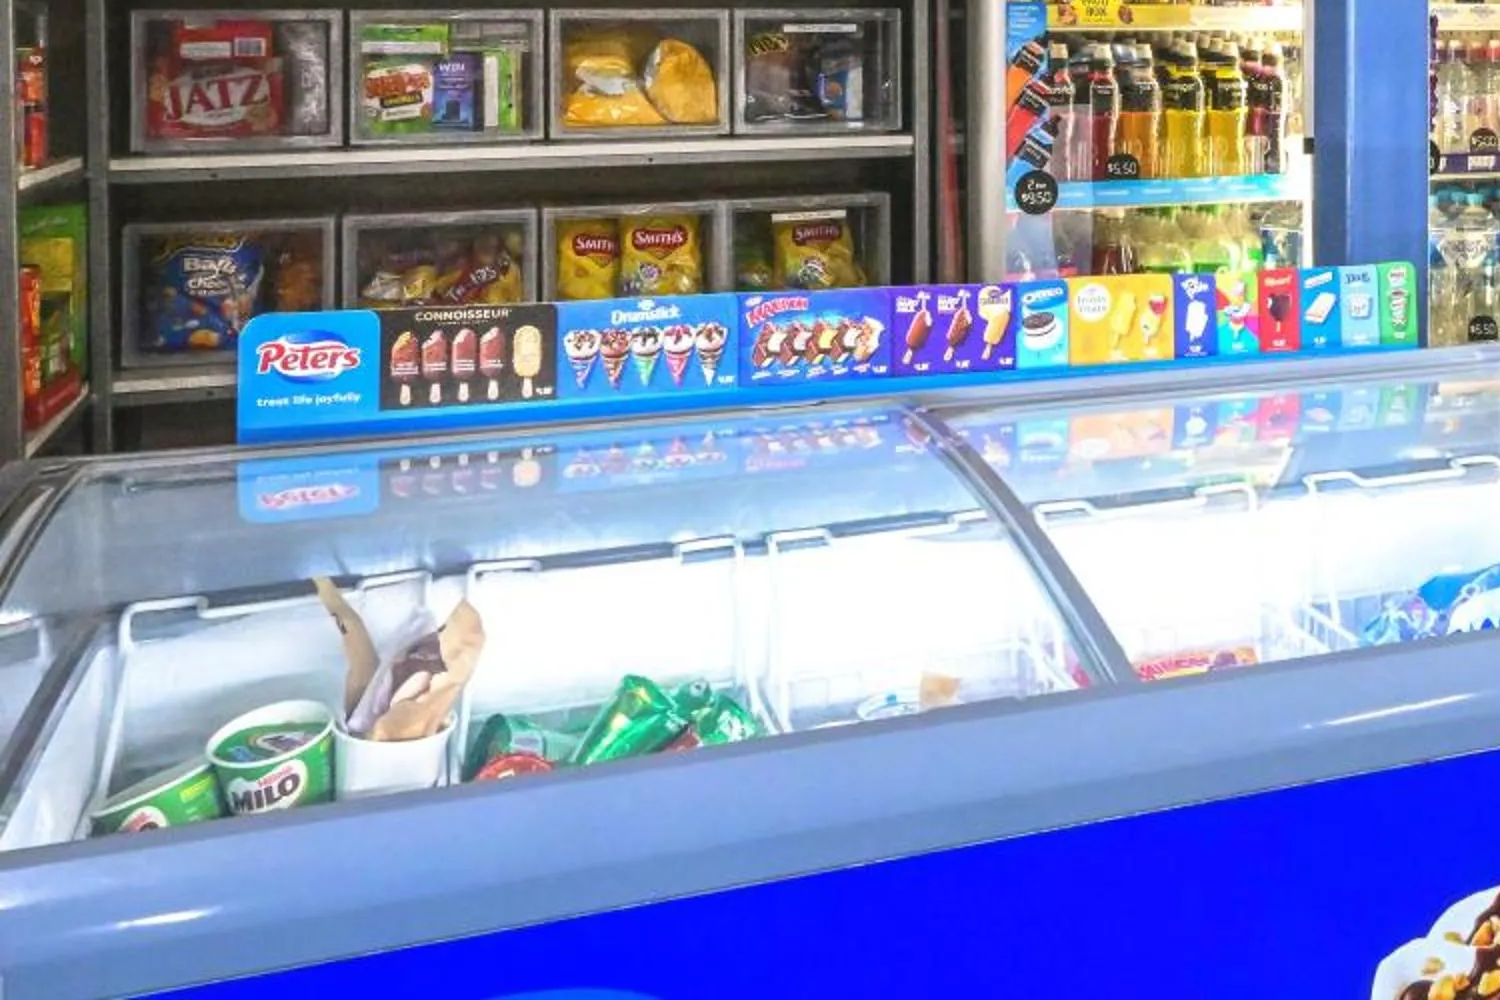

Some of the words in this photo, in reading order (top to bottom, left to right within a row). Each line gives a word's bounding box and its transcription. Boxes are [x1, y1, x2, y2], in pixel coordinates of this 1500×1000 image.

[164, 74, 270, 122] JATZ
[635, 229, 685, 246] SMITH'S
[415, 309, 509, 322] CONNOISSEUR
[611, 305, 682, 325] Drumstick
[257, 341, 361, 374] Peters
[231, 773, 300, 811] MILO
